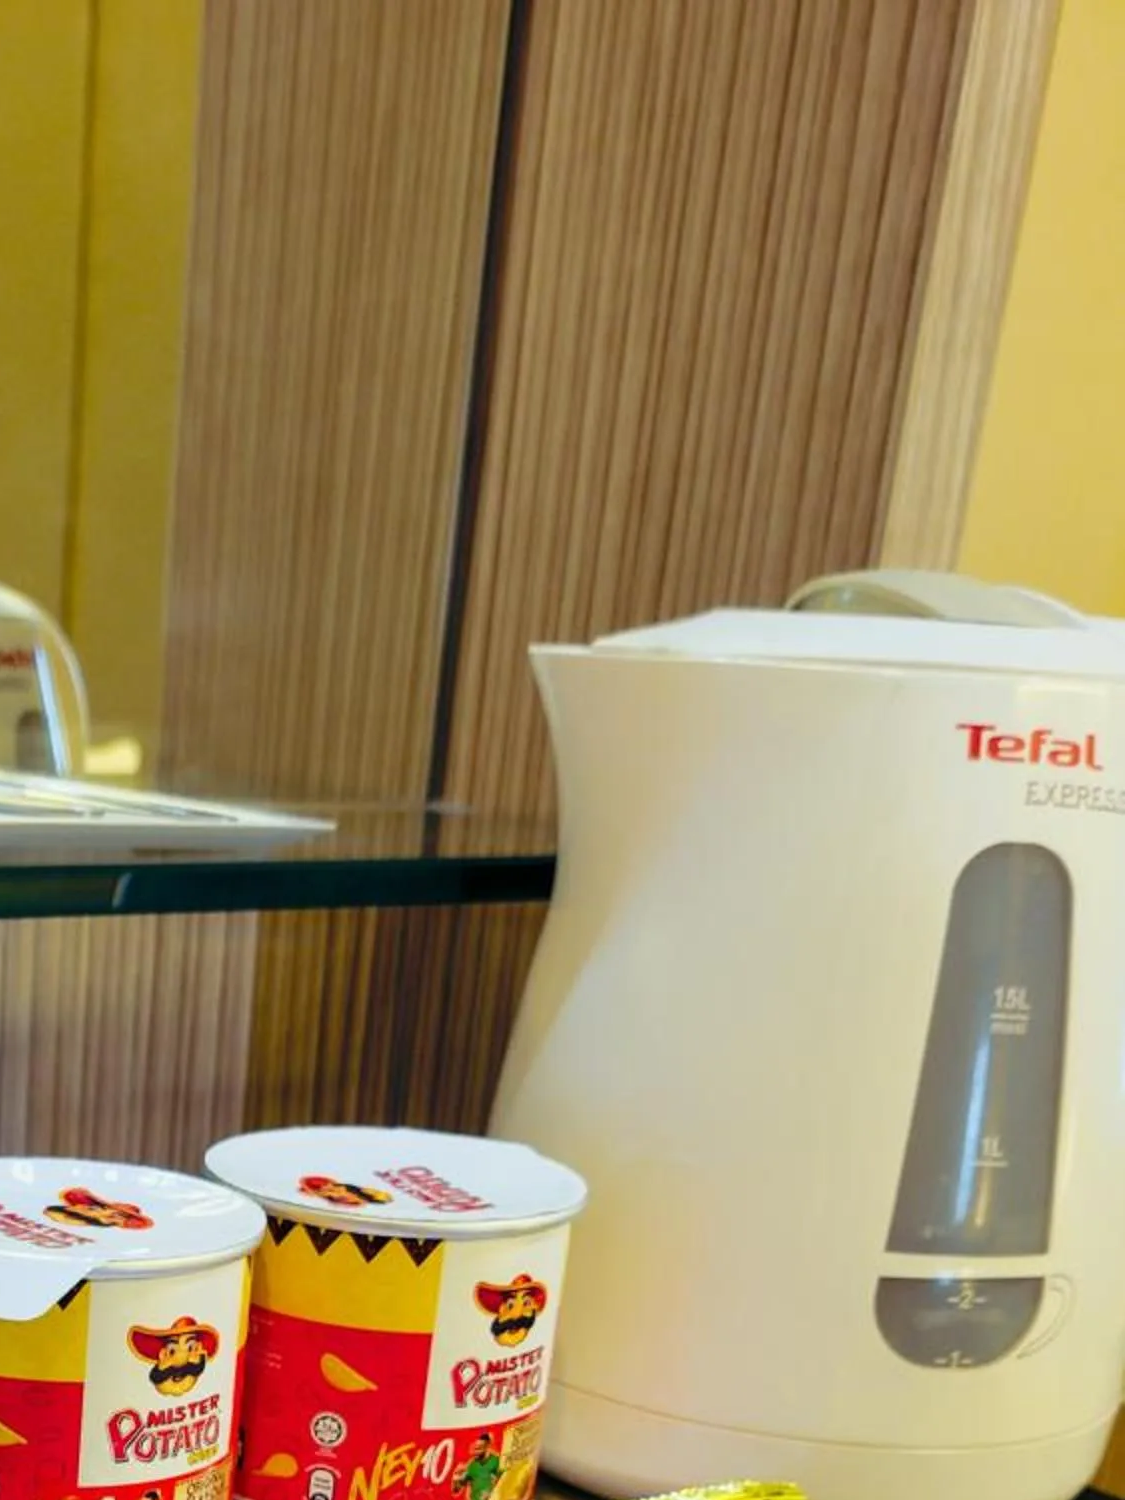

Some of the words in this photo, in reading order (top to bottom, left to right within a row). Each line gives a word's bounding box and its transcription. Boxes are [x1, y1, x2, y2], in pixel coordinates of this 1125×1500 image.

[955, 722, 1104, 771] Tefal
[449, 1358, 542, 1409] POTATO
[107, 1407, 221, 1464] POTATO
[146, 1394, 221, 1428] MISTER
